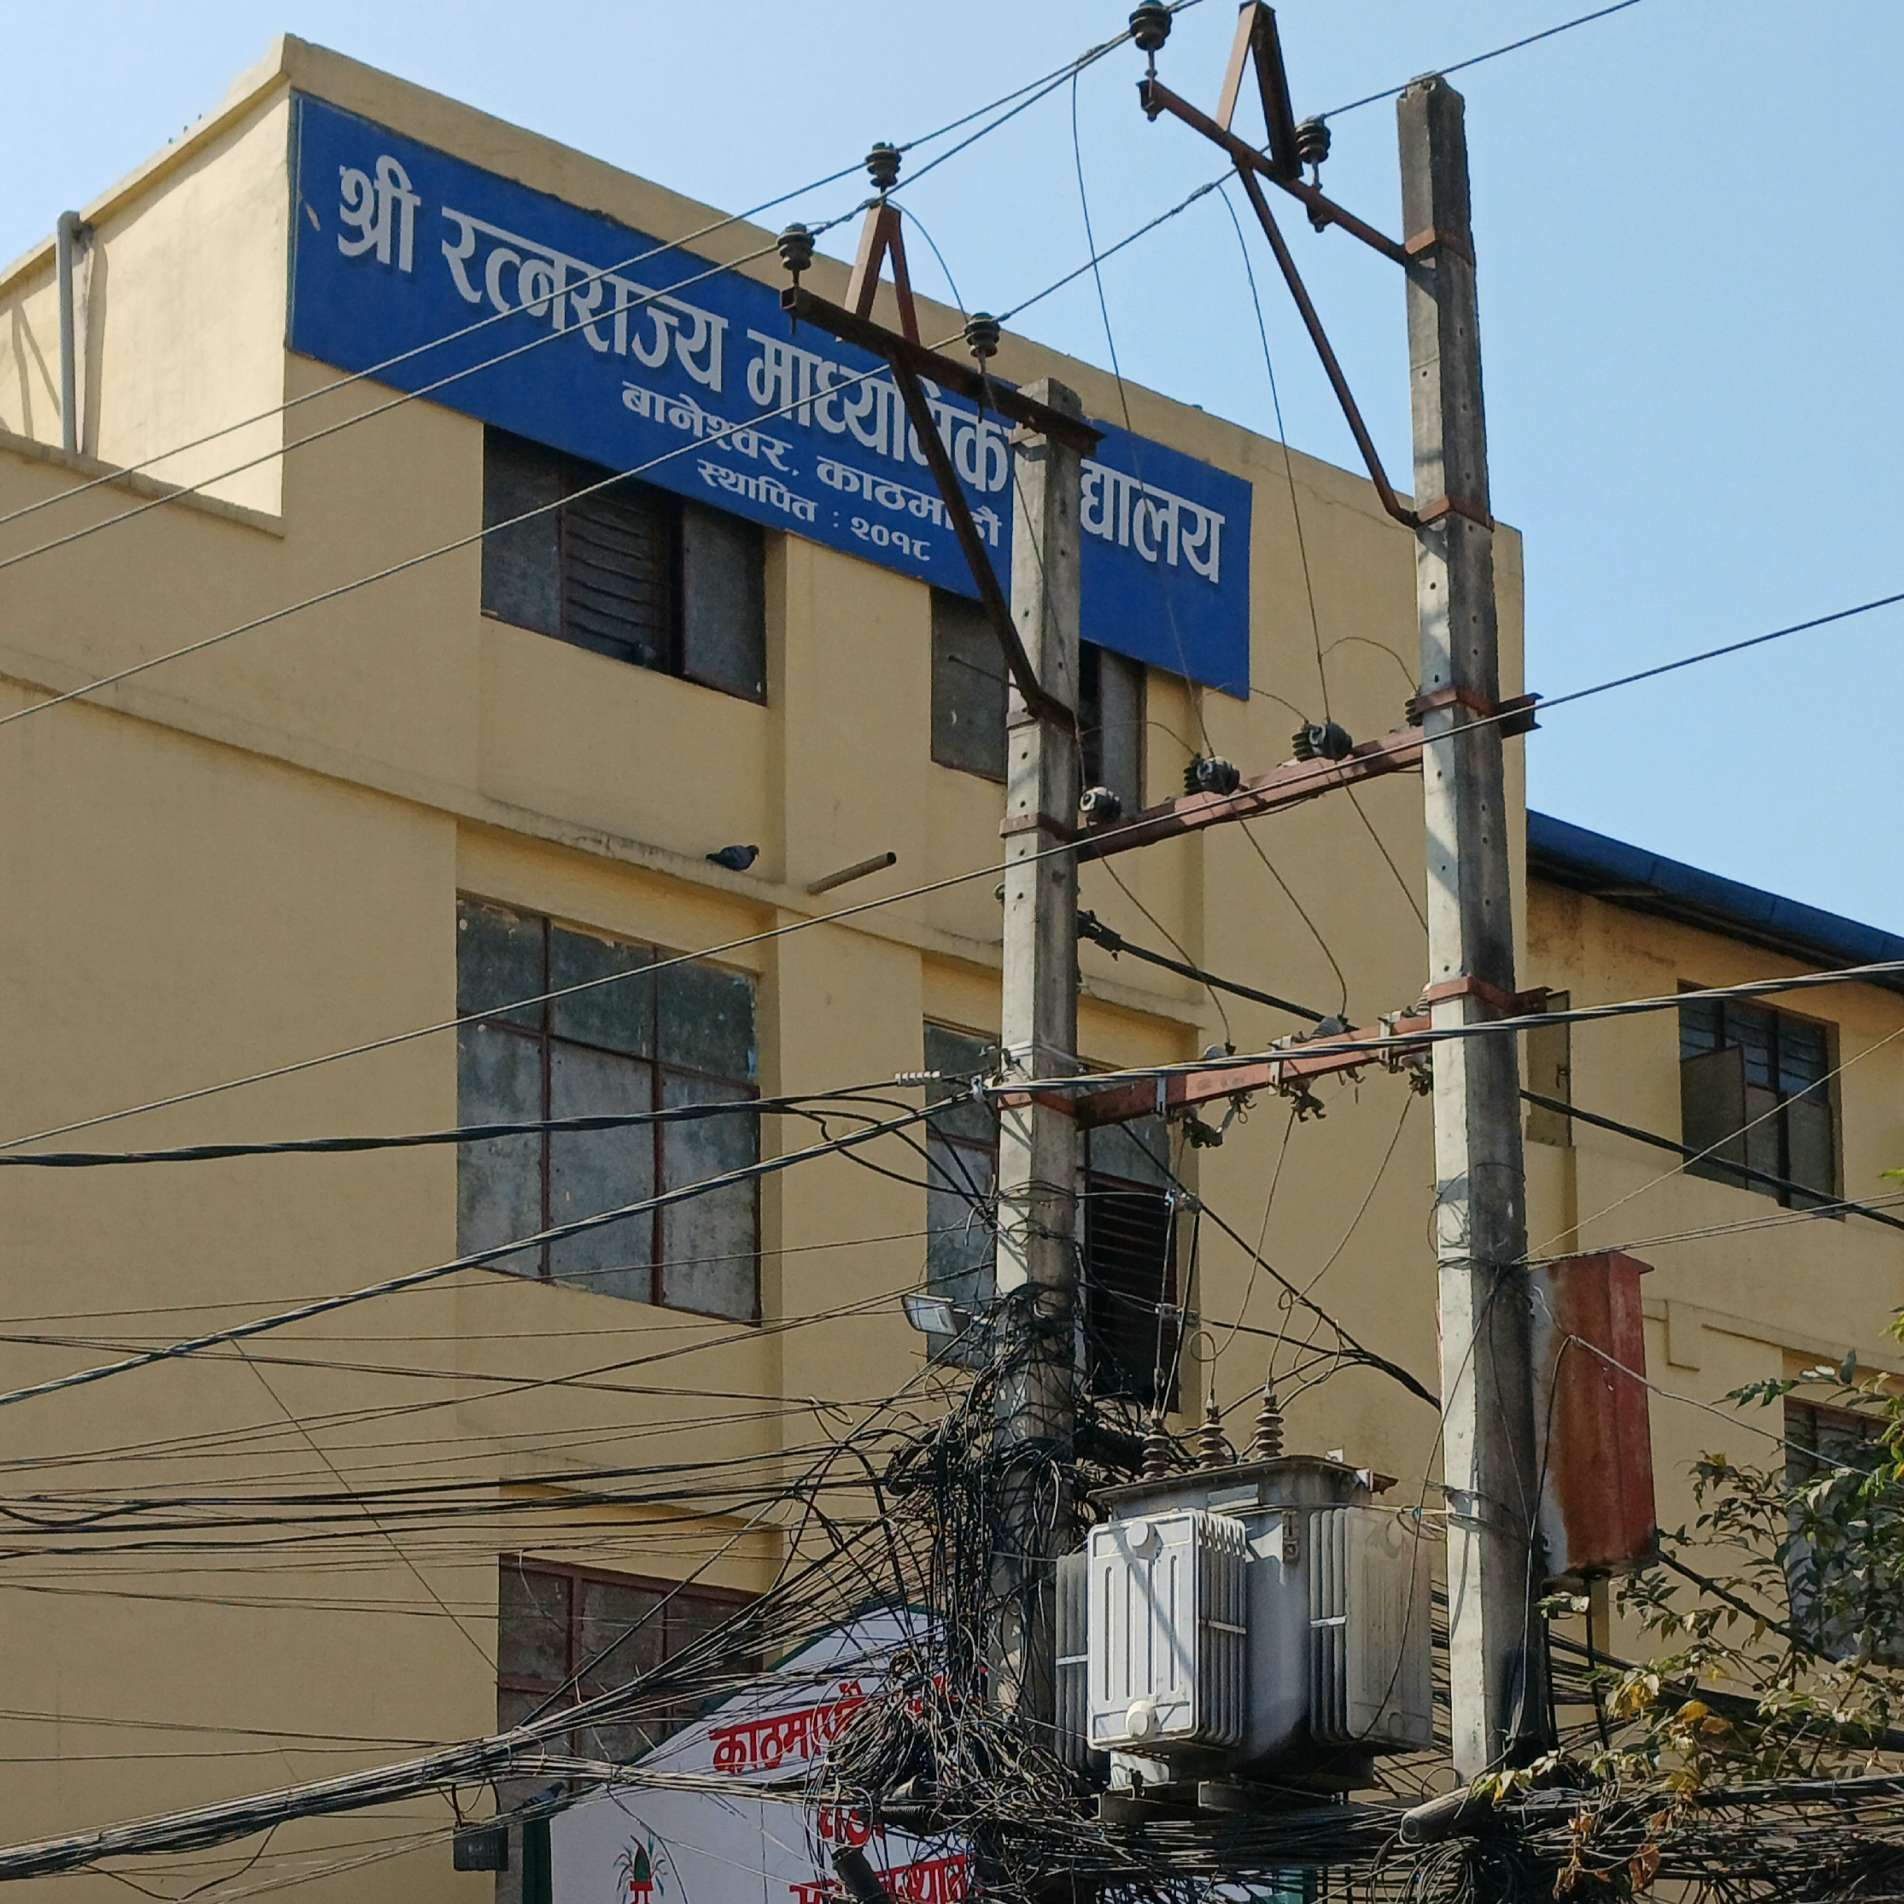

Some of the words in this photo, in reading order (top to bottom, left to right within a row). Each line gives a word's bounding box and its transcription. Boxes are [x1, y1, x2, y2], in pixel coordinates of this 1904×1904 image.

[337, 154, 421, 273] श्री
[441, 206, 729, 393] रत्नराज्य
[697, 458, 818, 523] स्थापित
[849, 516, 931, 561] २०१८
